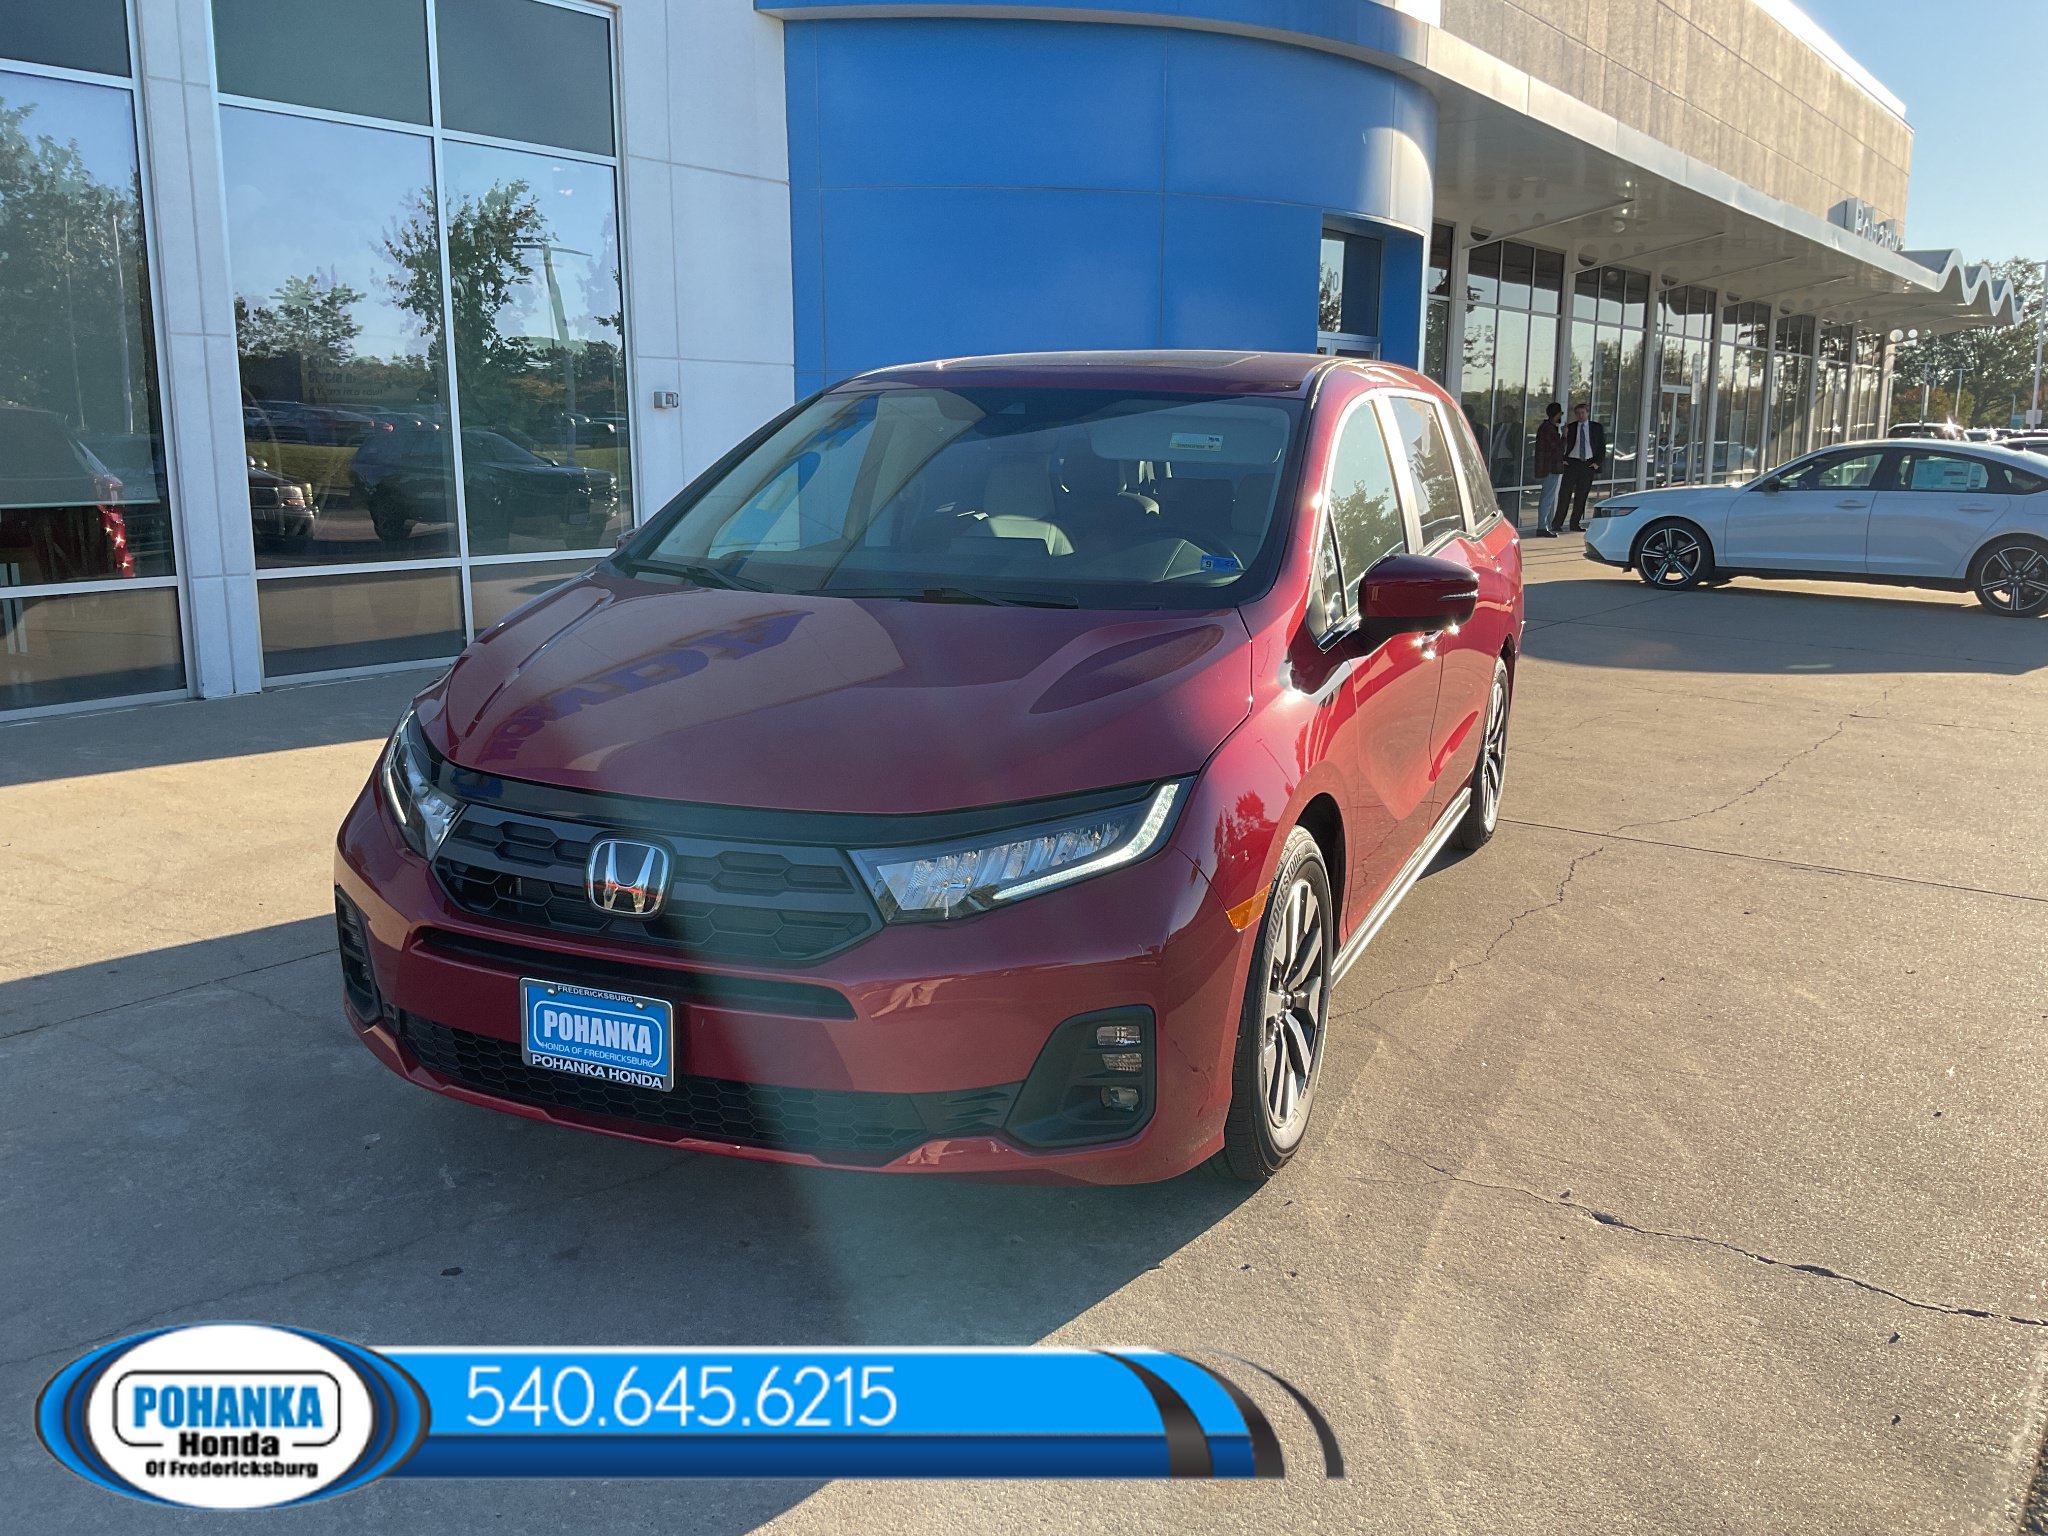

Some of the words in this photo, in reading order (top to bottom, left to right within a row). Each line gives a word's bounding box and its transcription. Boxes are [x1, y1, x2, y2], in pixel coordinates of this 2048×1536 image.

[557, 985, 635, 1003] FREDERICKSBURG
[543, 1009, 652, 1055] POHANKA
[541, 1041, 570, 1053] HONDA
[571, 1046, 583, 1056] OF
[584, 1048, 655, 1068] FREDERICKSBURG
[532, 1054, 606, 1078] POHANKA
[608, 1068, 663, 1089] HONDA
